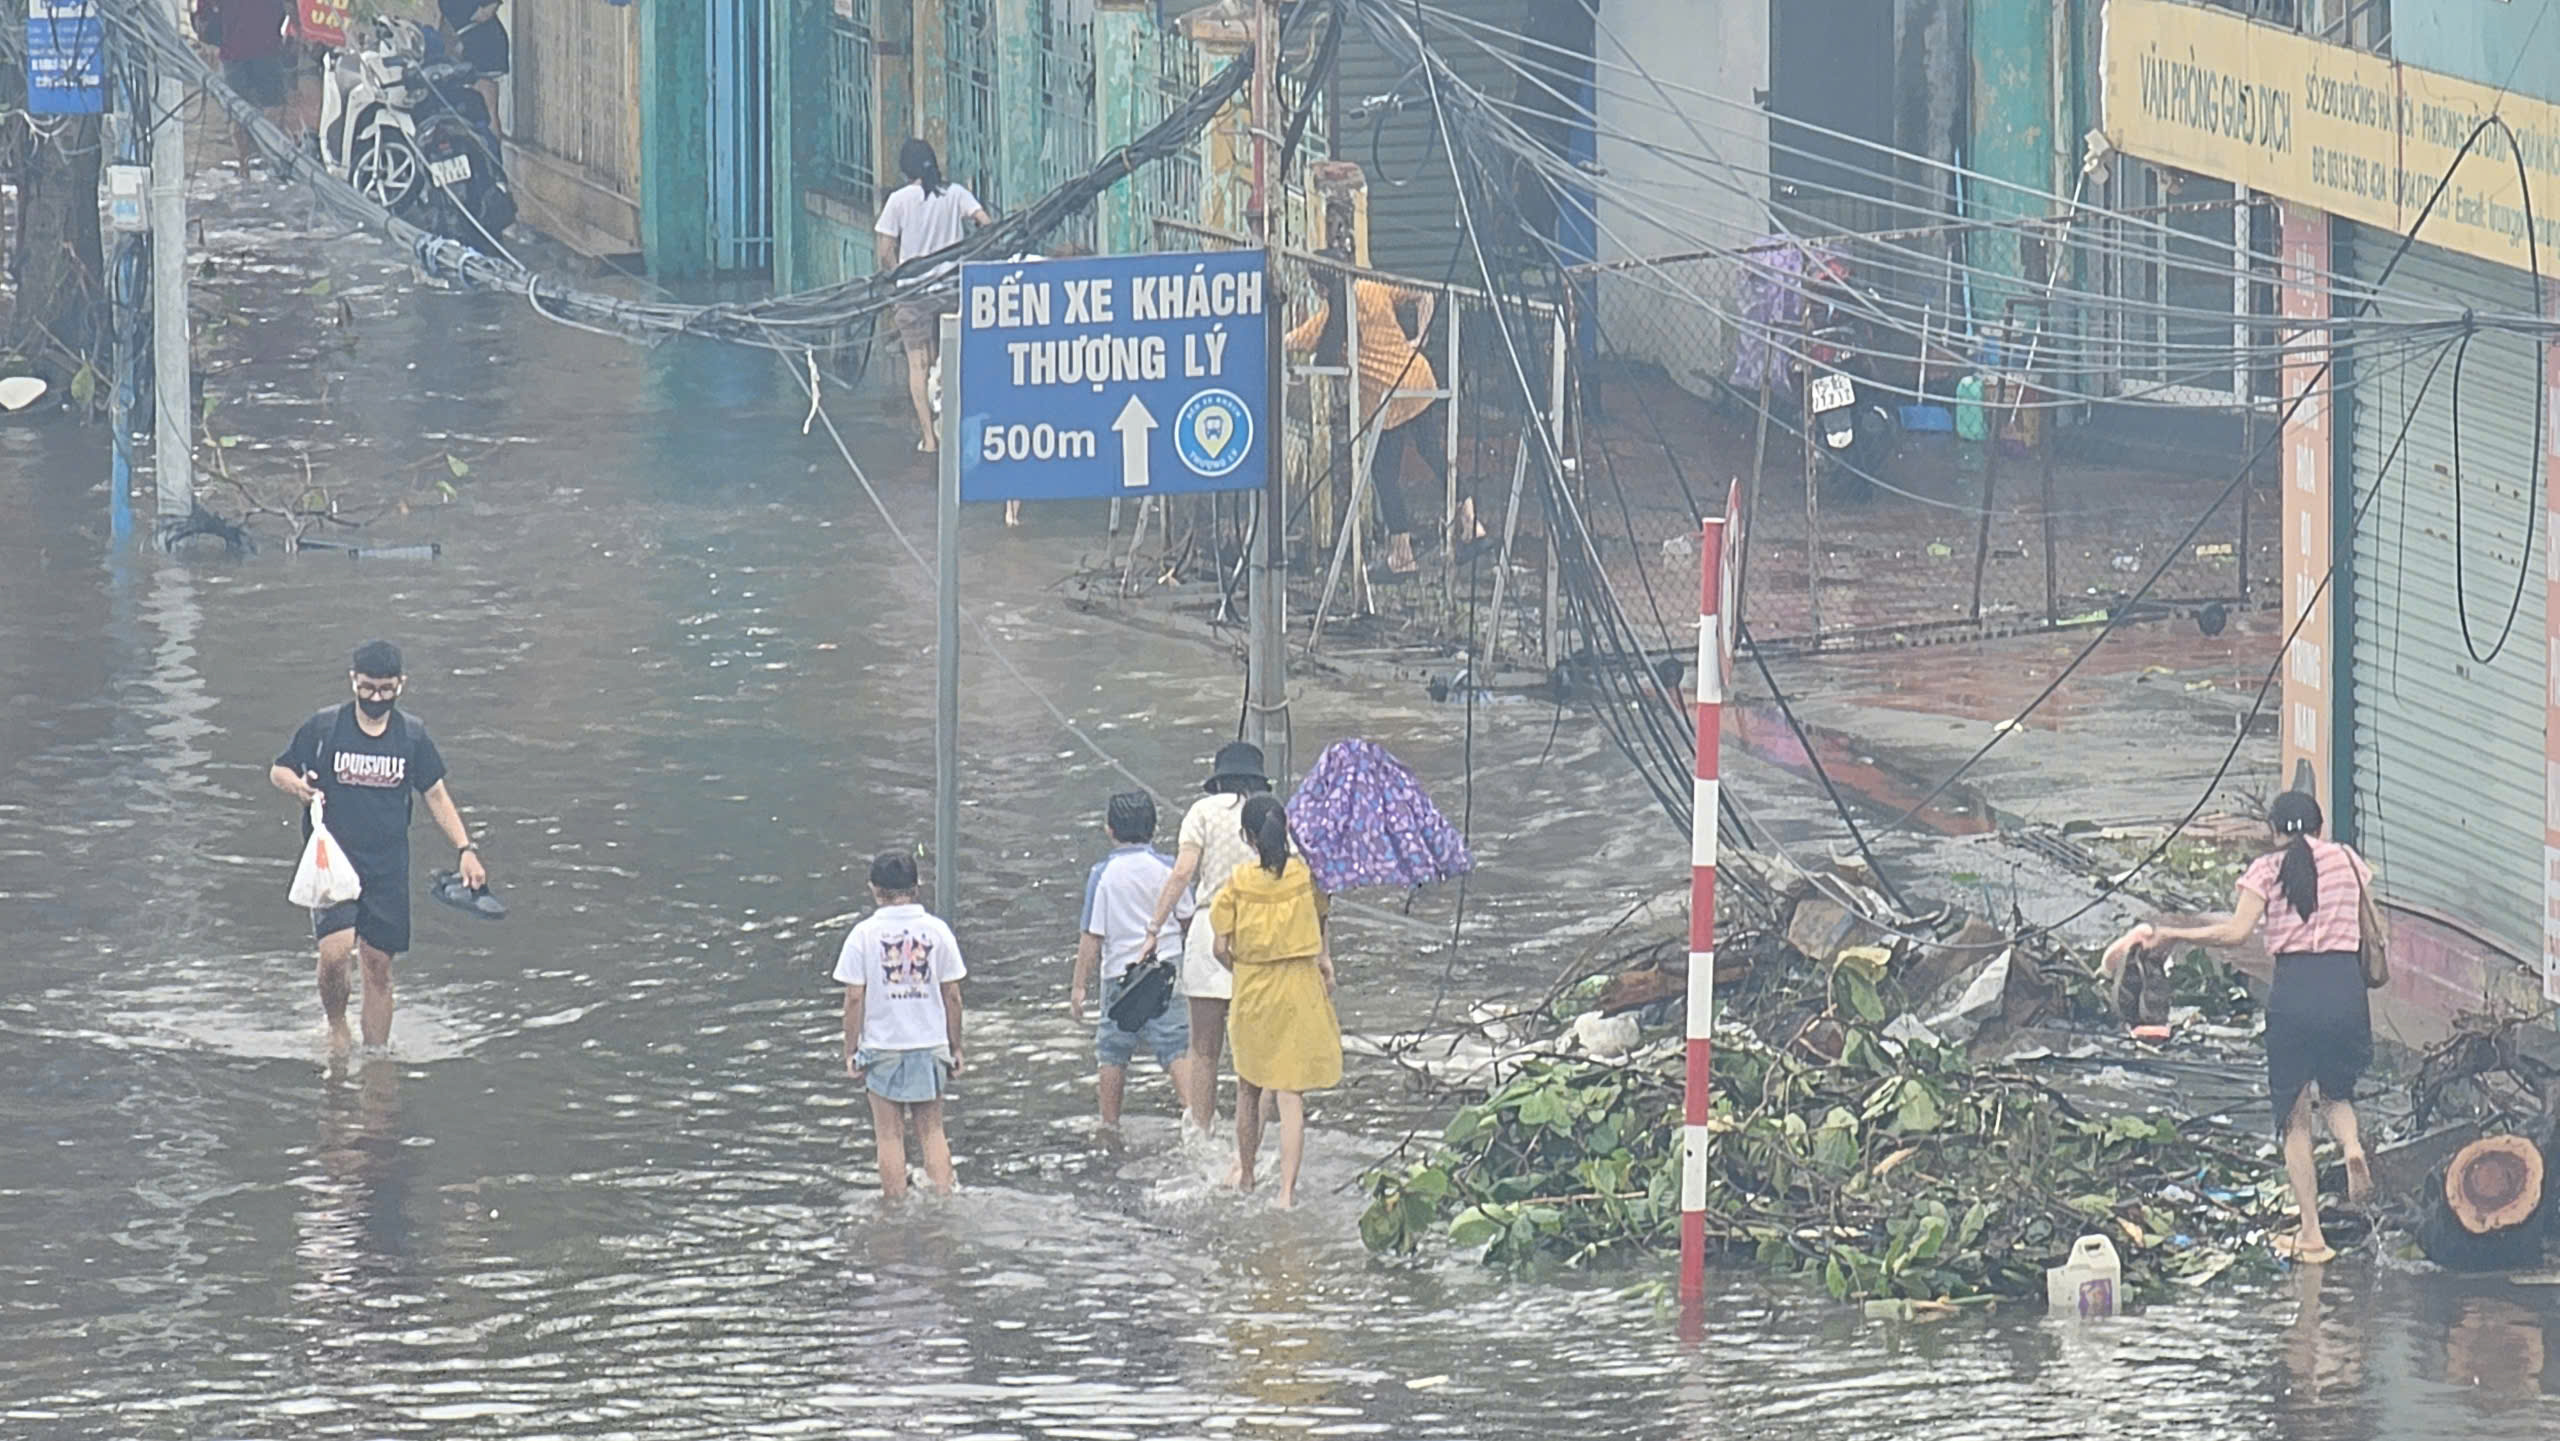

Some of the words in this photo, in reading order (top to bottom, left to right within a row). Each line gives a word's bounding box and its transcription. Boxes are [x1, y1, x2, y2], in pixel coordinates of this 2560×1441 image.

[2140, 41, 2169, 122] VĂN
[2171, 44, 2219, 134] PHÒNG
[2259, 84, 2293, 163] DỊCH
[2305, 57, 2319, 112] SỐ
[971, 270, 1050, 329] BẾN
[1064, 279, 1113, 325] XE
[1132, 263, 1262, 321] KHÁCH
[1008, 334, 1166, 392] THƯỢNG
[1185, 322, 1228, 377] LÝ
[983, 422, 1096, 461] 500m
[334, 751, 406, 780] LOUISVILLE
